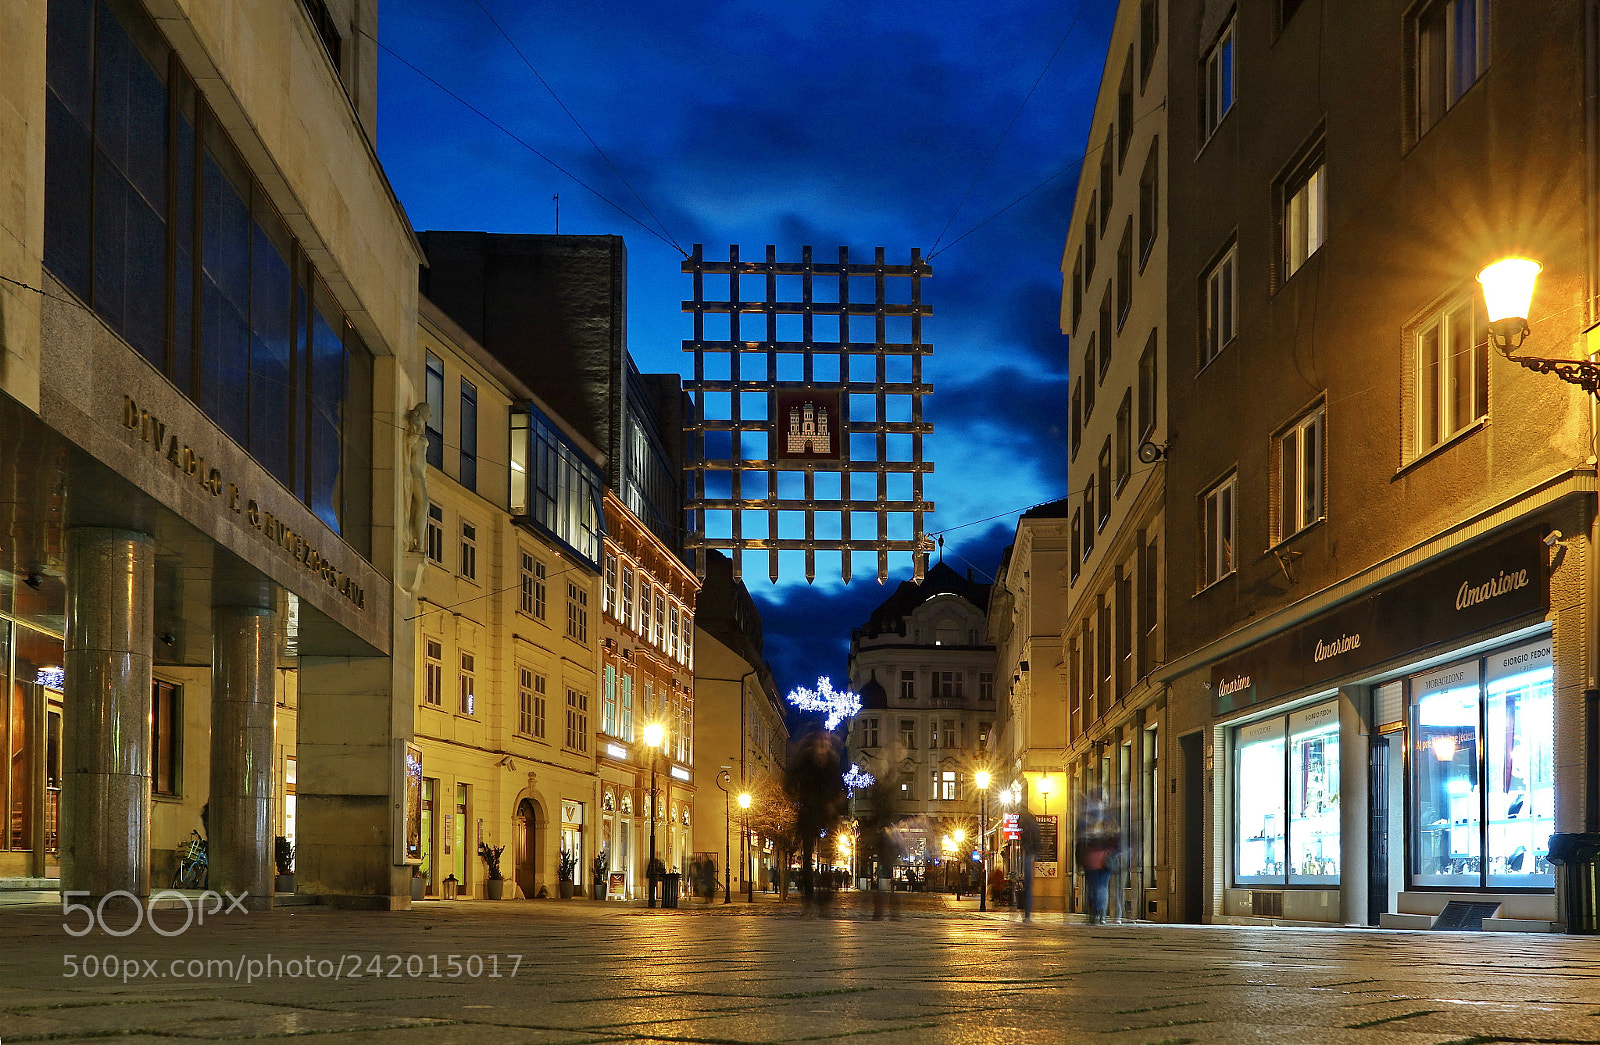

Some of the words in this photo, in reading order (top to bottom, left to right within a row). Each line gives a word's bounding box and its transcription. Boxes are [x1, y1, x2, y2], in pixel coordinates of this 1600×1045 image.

[122, 395, 222, 497] DIVADLO
[264, 511, 365, 611] HVIEZDOSLAVA
[1455, 568, 1529, 611] Amarione
[1314, 633, 1361, 663] Amarione
[1503, 653, 1528, 667] GIORGIO
[1530, 647, 1551, 659] FEDON
[1218, 674, 1252, 698] Amarione
